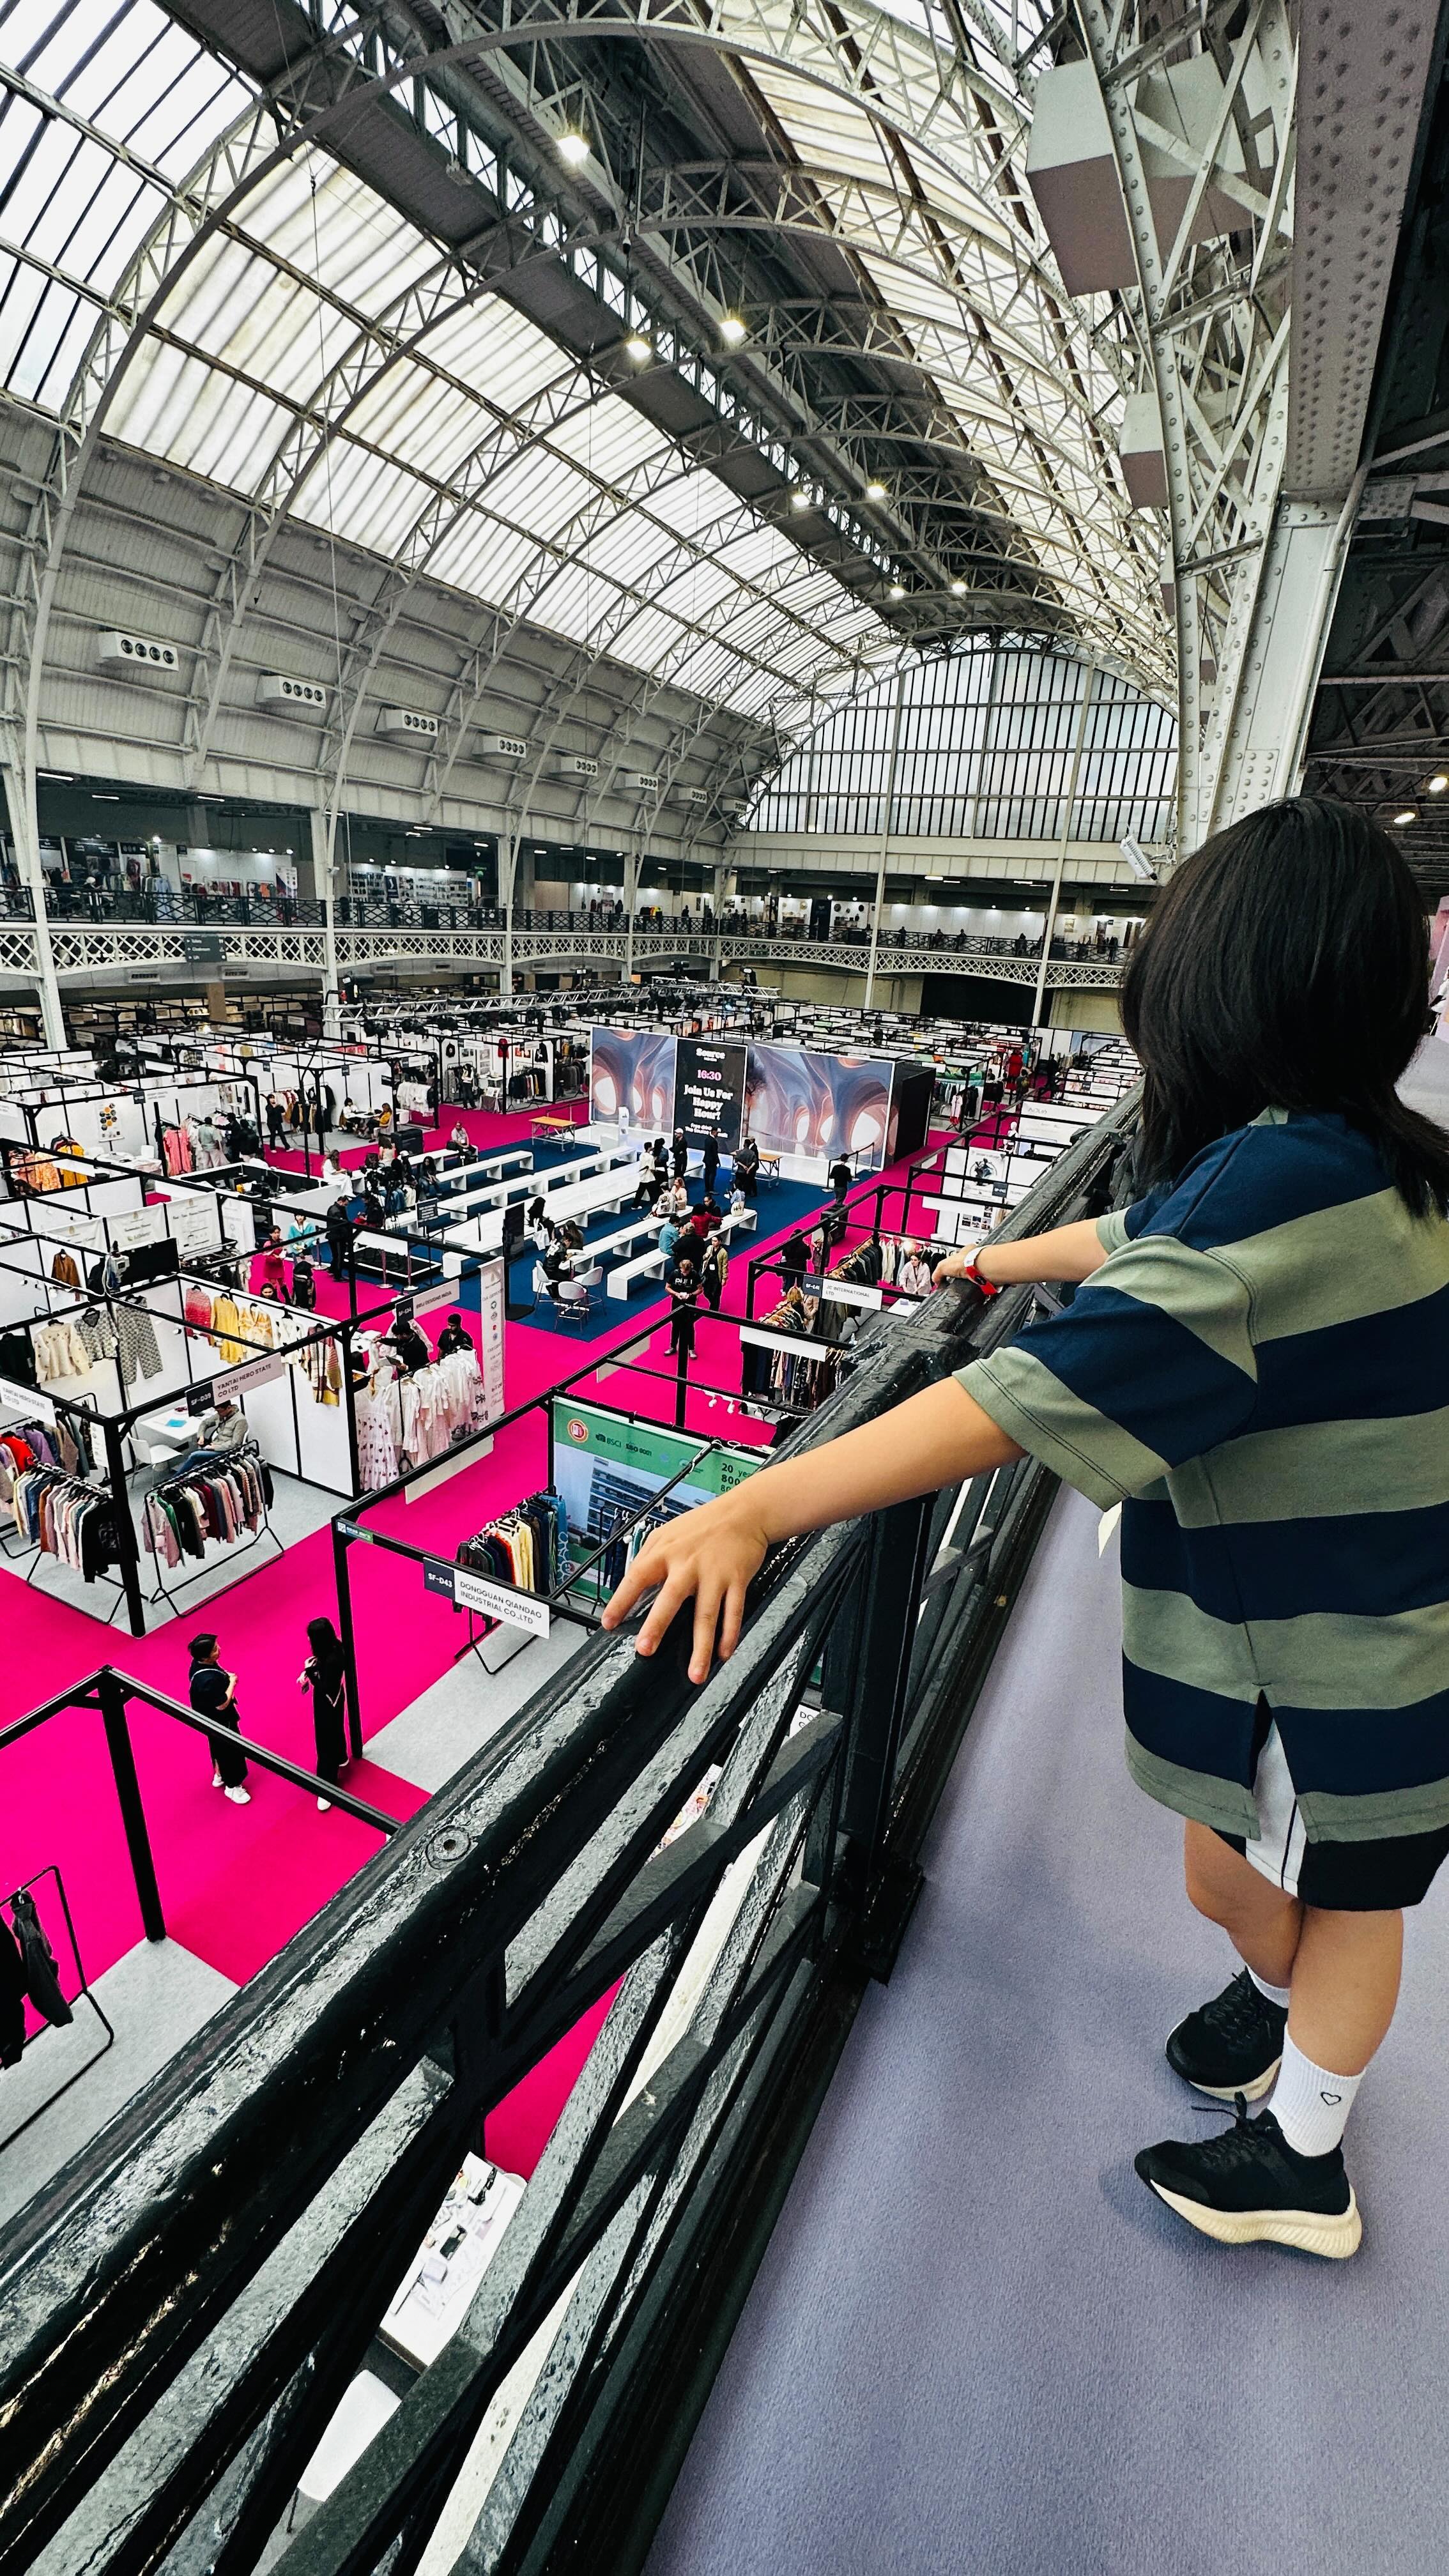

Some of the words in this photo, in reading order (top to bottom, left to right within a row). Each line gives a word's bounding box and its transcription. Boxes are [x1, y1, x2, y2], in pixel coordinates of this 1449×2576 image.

[696, 1048, 725, 1059] Source
[698, 1070, 721, 1081] 16:30
[684, 1084, 702, 1096] Join
[703, 1087, 716, 1098] Us
[716, 1089, 733, 1100] For
[693, 1097, 723, 1111] Happy
[834, 1287, 870, 1298] INTERNATIONAL
[217, 1377, 239, 1390] YANTAI
[240, 1370, 254, 1381] HERO
[255, 1363, 272, 1374] STATE
[228, 1385, 239, 1393] LTD
[606, 1438, 622, 1448] BSCI
[721, 1463, 733, 1473] 20
[427, 1572, 453, 1588] SF-D43
[460, 1581, 503, 1604] DONGGUAN
[505, 1599, 542, 1618] QIANDAO
[461, 1590, 502, 1613] INDUSTRIAL
